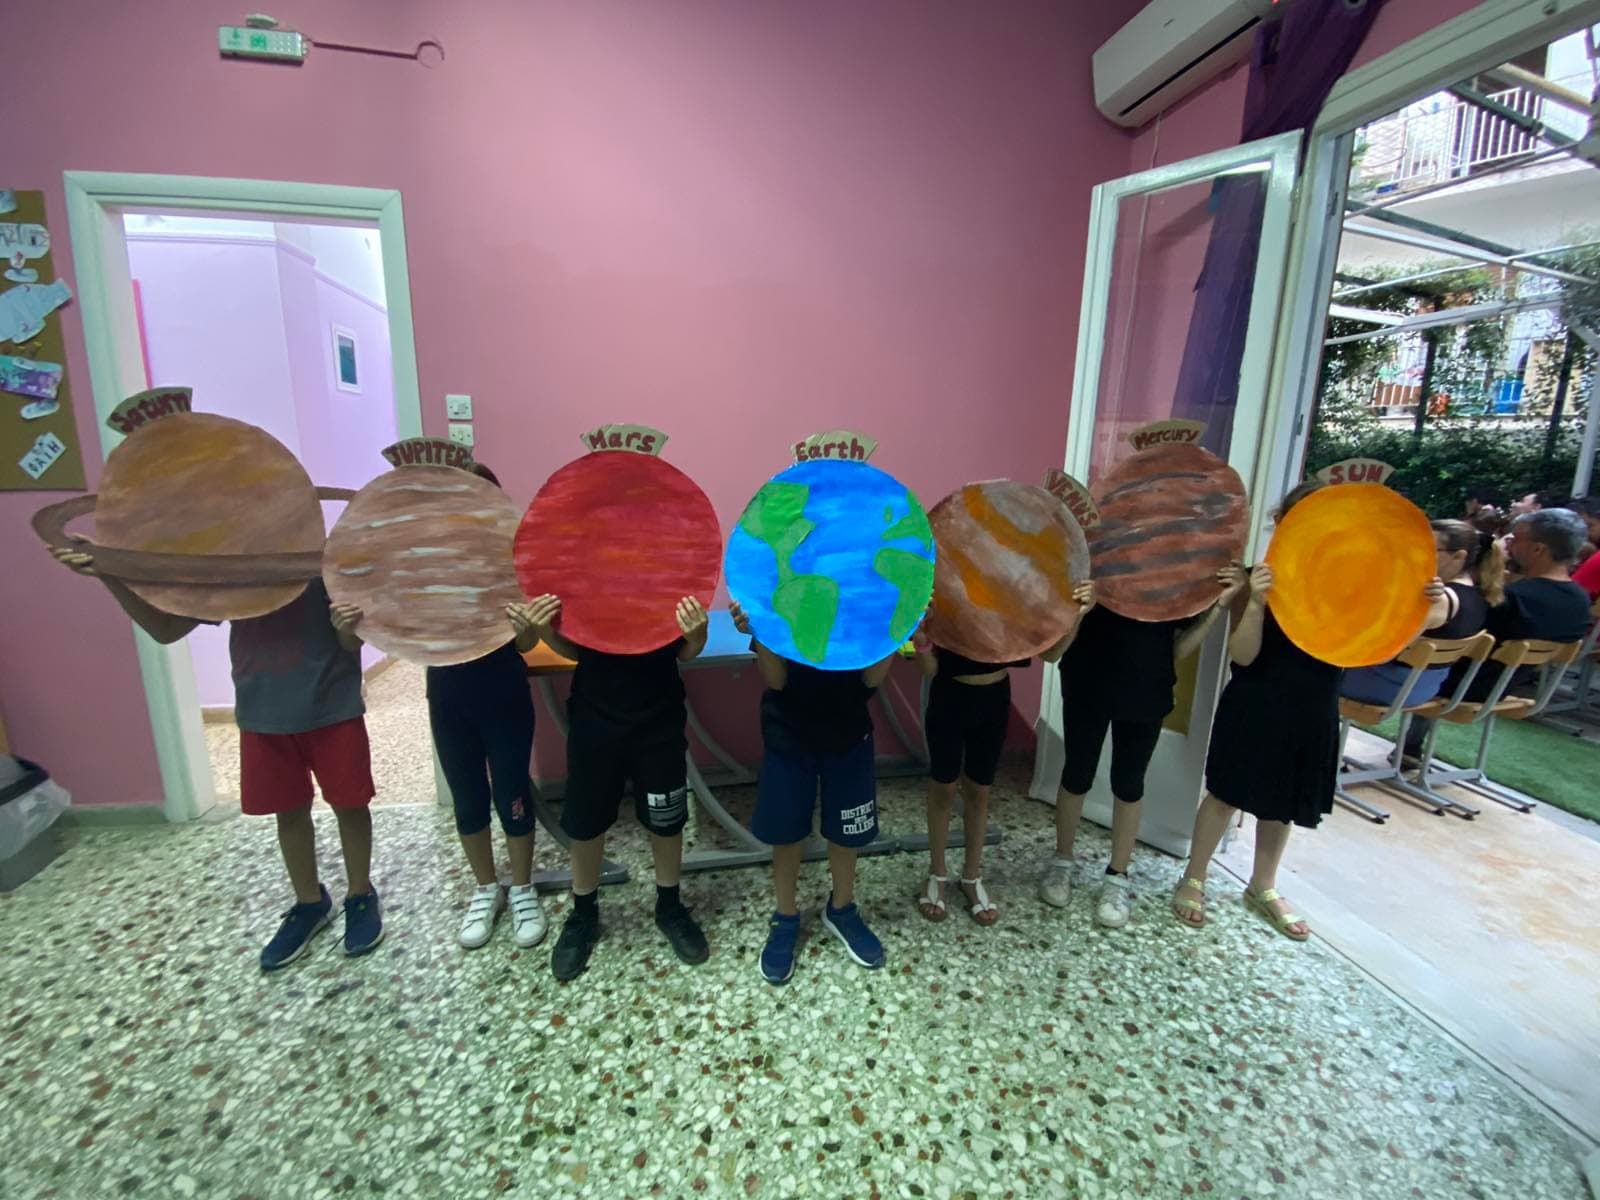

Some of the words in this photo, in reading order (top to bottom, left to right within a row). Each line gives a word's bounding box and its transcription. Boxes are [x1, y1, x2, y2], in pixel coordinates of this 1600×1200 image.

[589, 428, 656, 452] Mars
[795, 437, 865, 462] Earth
[1134, 428, 1201, 451] Mercury
[382, 440, 470, 468] JUPITER
[1329, 463, 1385, 486] SUN
